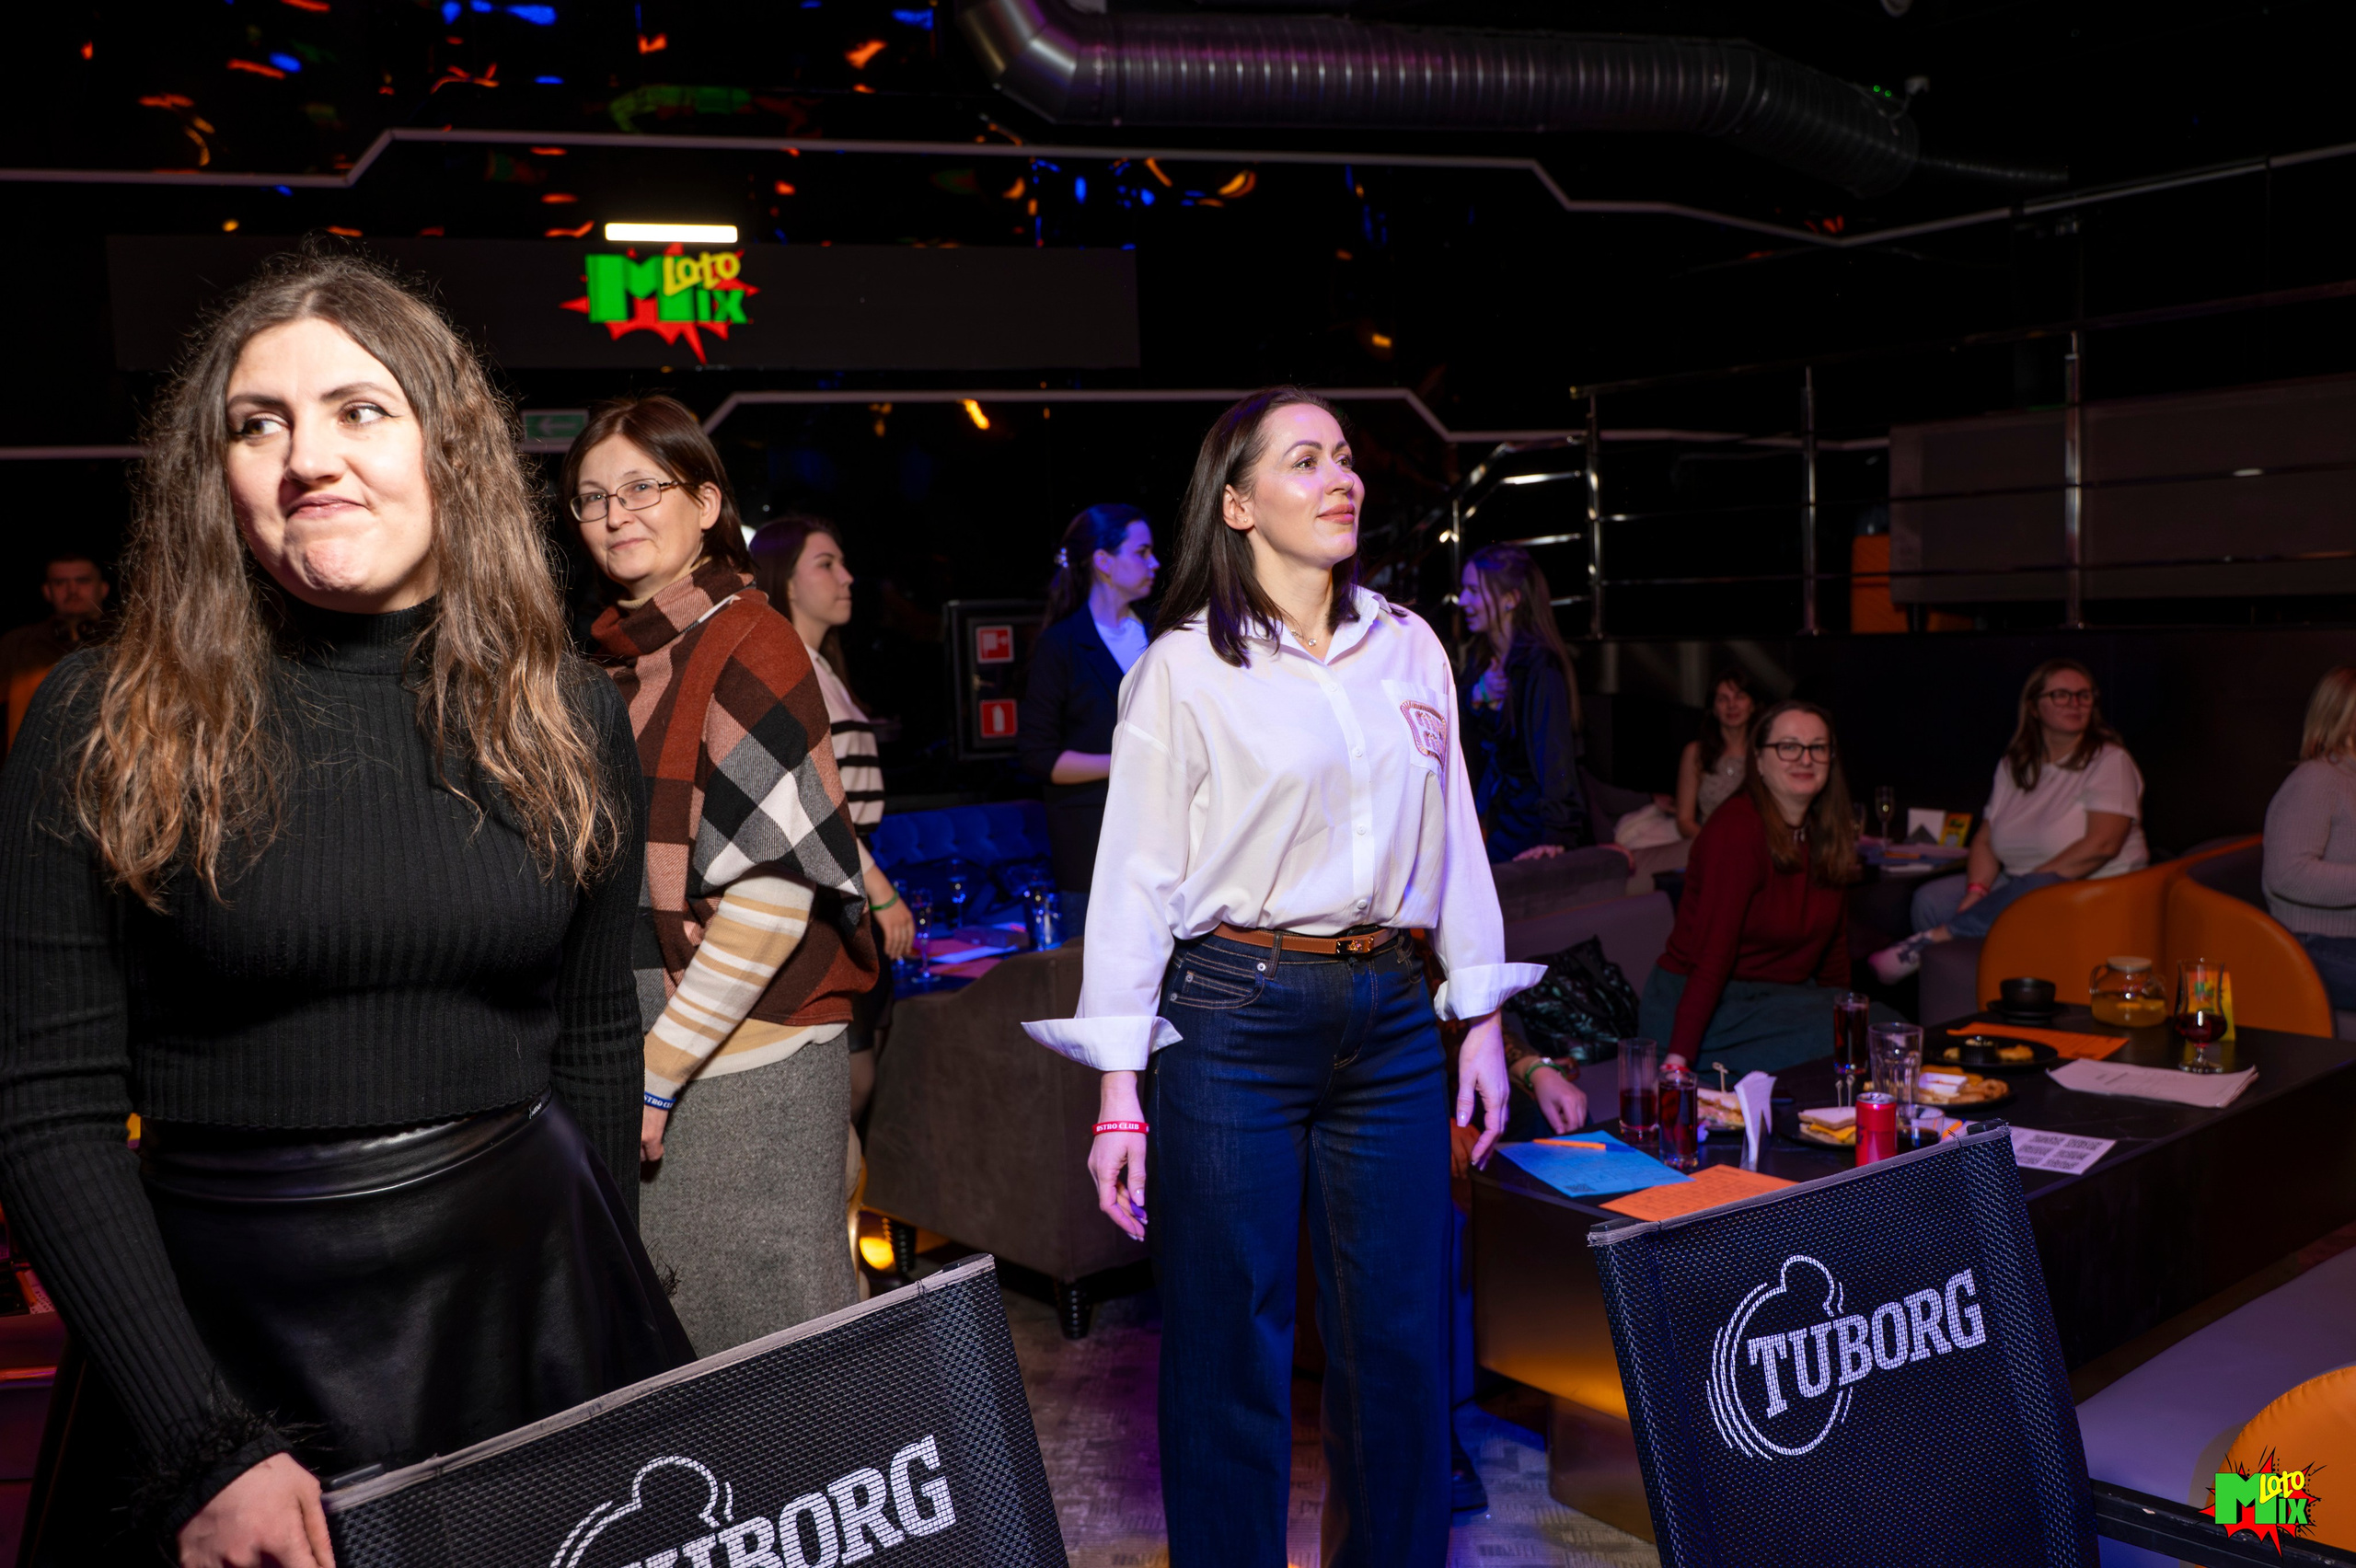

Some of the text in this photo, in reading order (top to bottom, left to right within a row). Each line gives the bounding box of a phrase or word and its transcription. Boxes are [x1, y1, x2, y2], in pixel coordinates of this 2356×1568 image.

[663, 251, 741, 296] Loto
[1747, 1268, 1986, 1418] TUBORG
[620, 1435, 956, 1568] BORG
